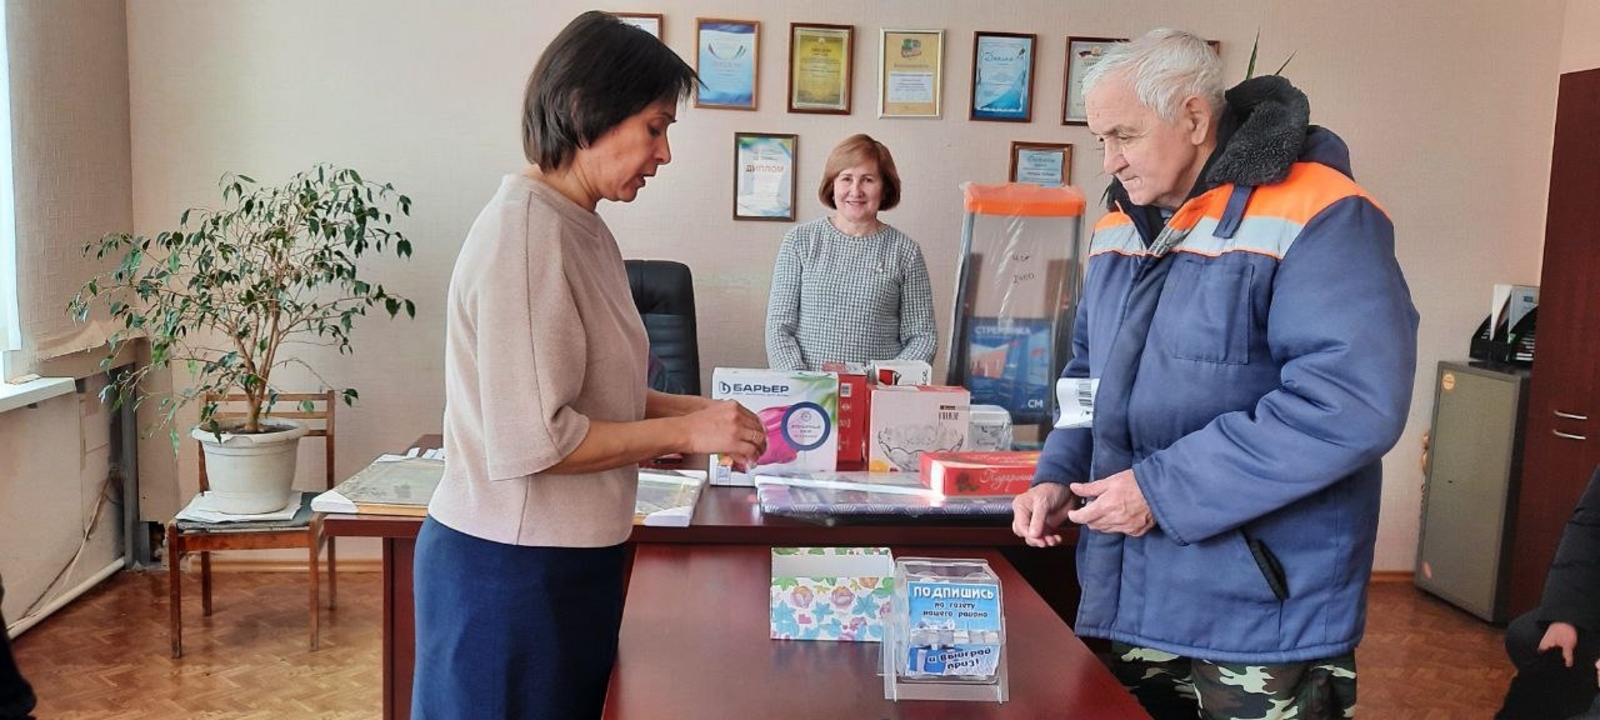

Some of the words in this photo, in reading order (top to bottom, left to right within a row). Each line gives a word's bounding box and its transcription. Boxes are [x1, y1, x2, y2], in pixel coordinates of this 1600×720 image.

[733, 383, 790, 394] БАРЬЕР
[1027, 399, 1044, 408] СМ
[913, 586, 995, 600] ПОДПИШИСЬ
[949, 602, 976, 610] газету
[947, 658, 980, 670] приз!
